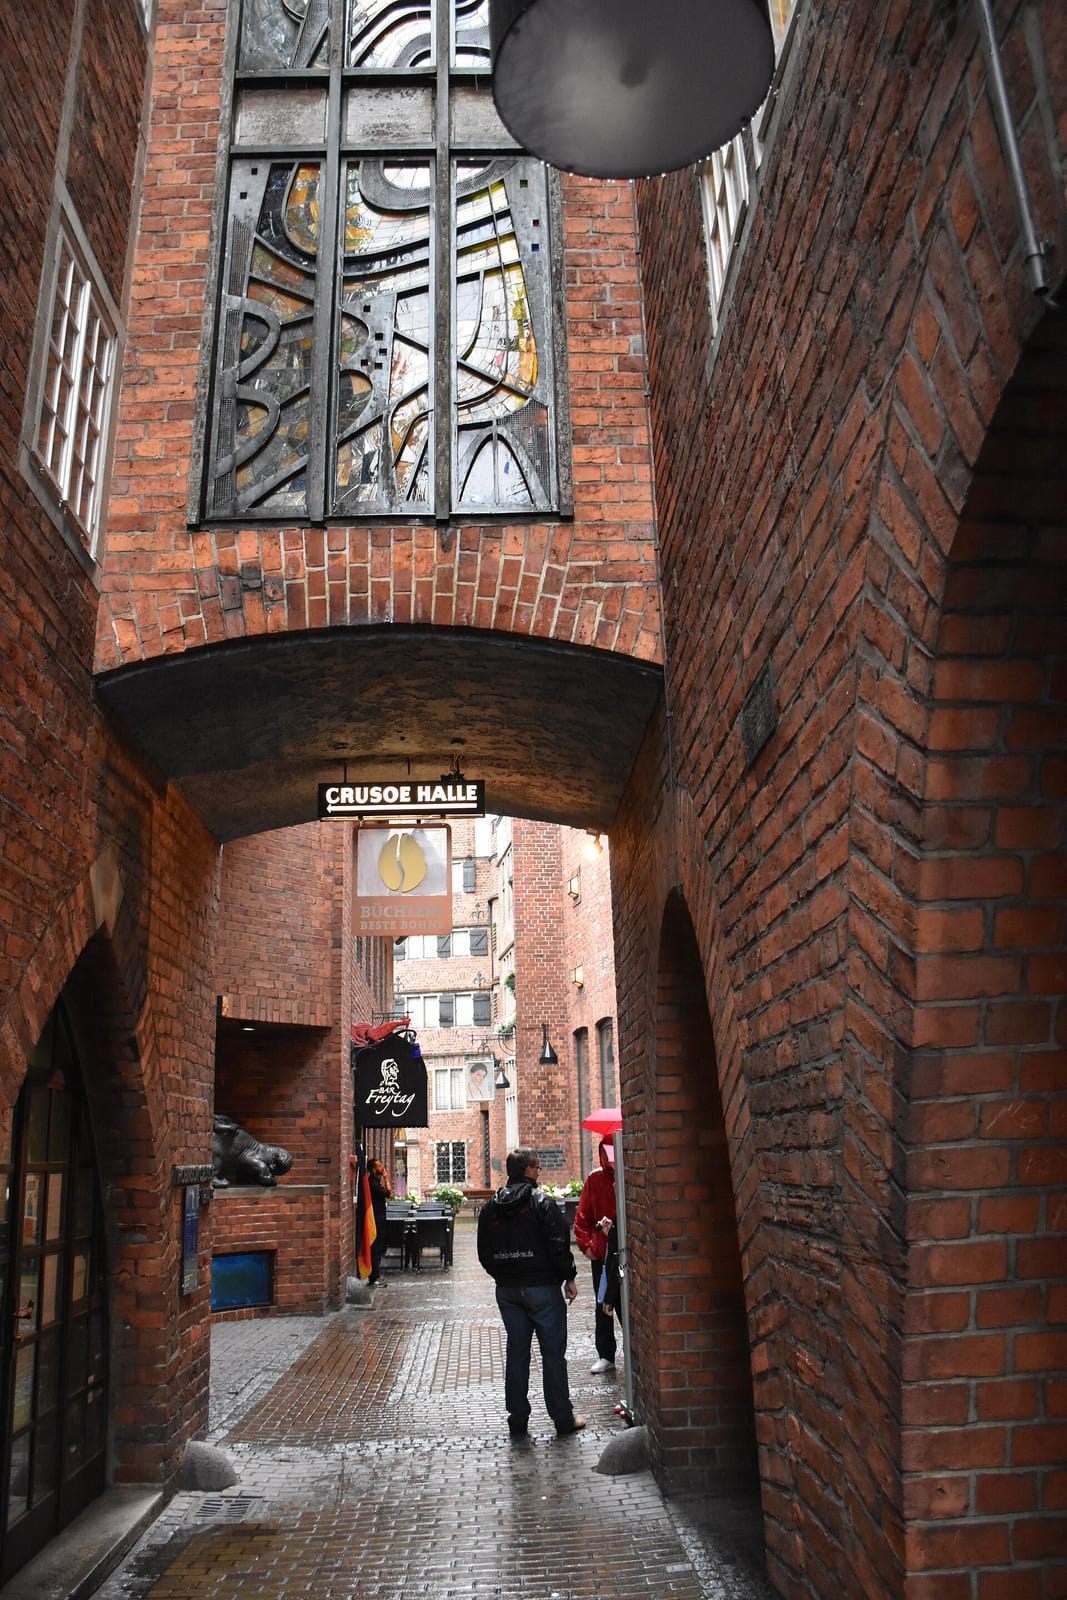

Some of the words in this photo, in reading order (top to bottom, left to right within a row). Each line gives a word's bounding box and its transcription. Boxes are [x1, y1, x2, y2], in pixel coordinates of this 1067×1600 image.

[325, 786, 411, 804] CRUSOE
[417, 784, 478, 803] HALLE
[359, 902, 445, 919] BÜCHLERS
[360, 920, 397, 931] BESTE
[379, 1086, 397, 1095] BAR
[365, 1089, 416, 1117] Freytag
